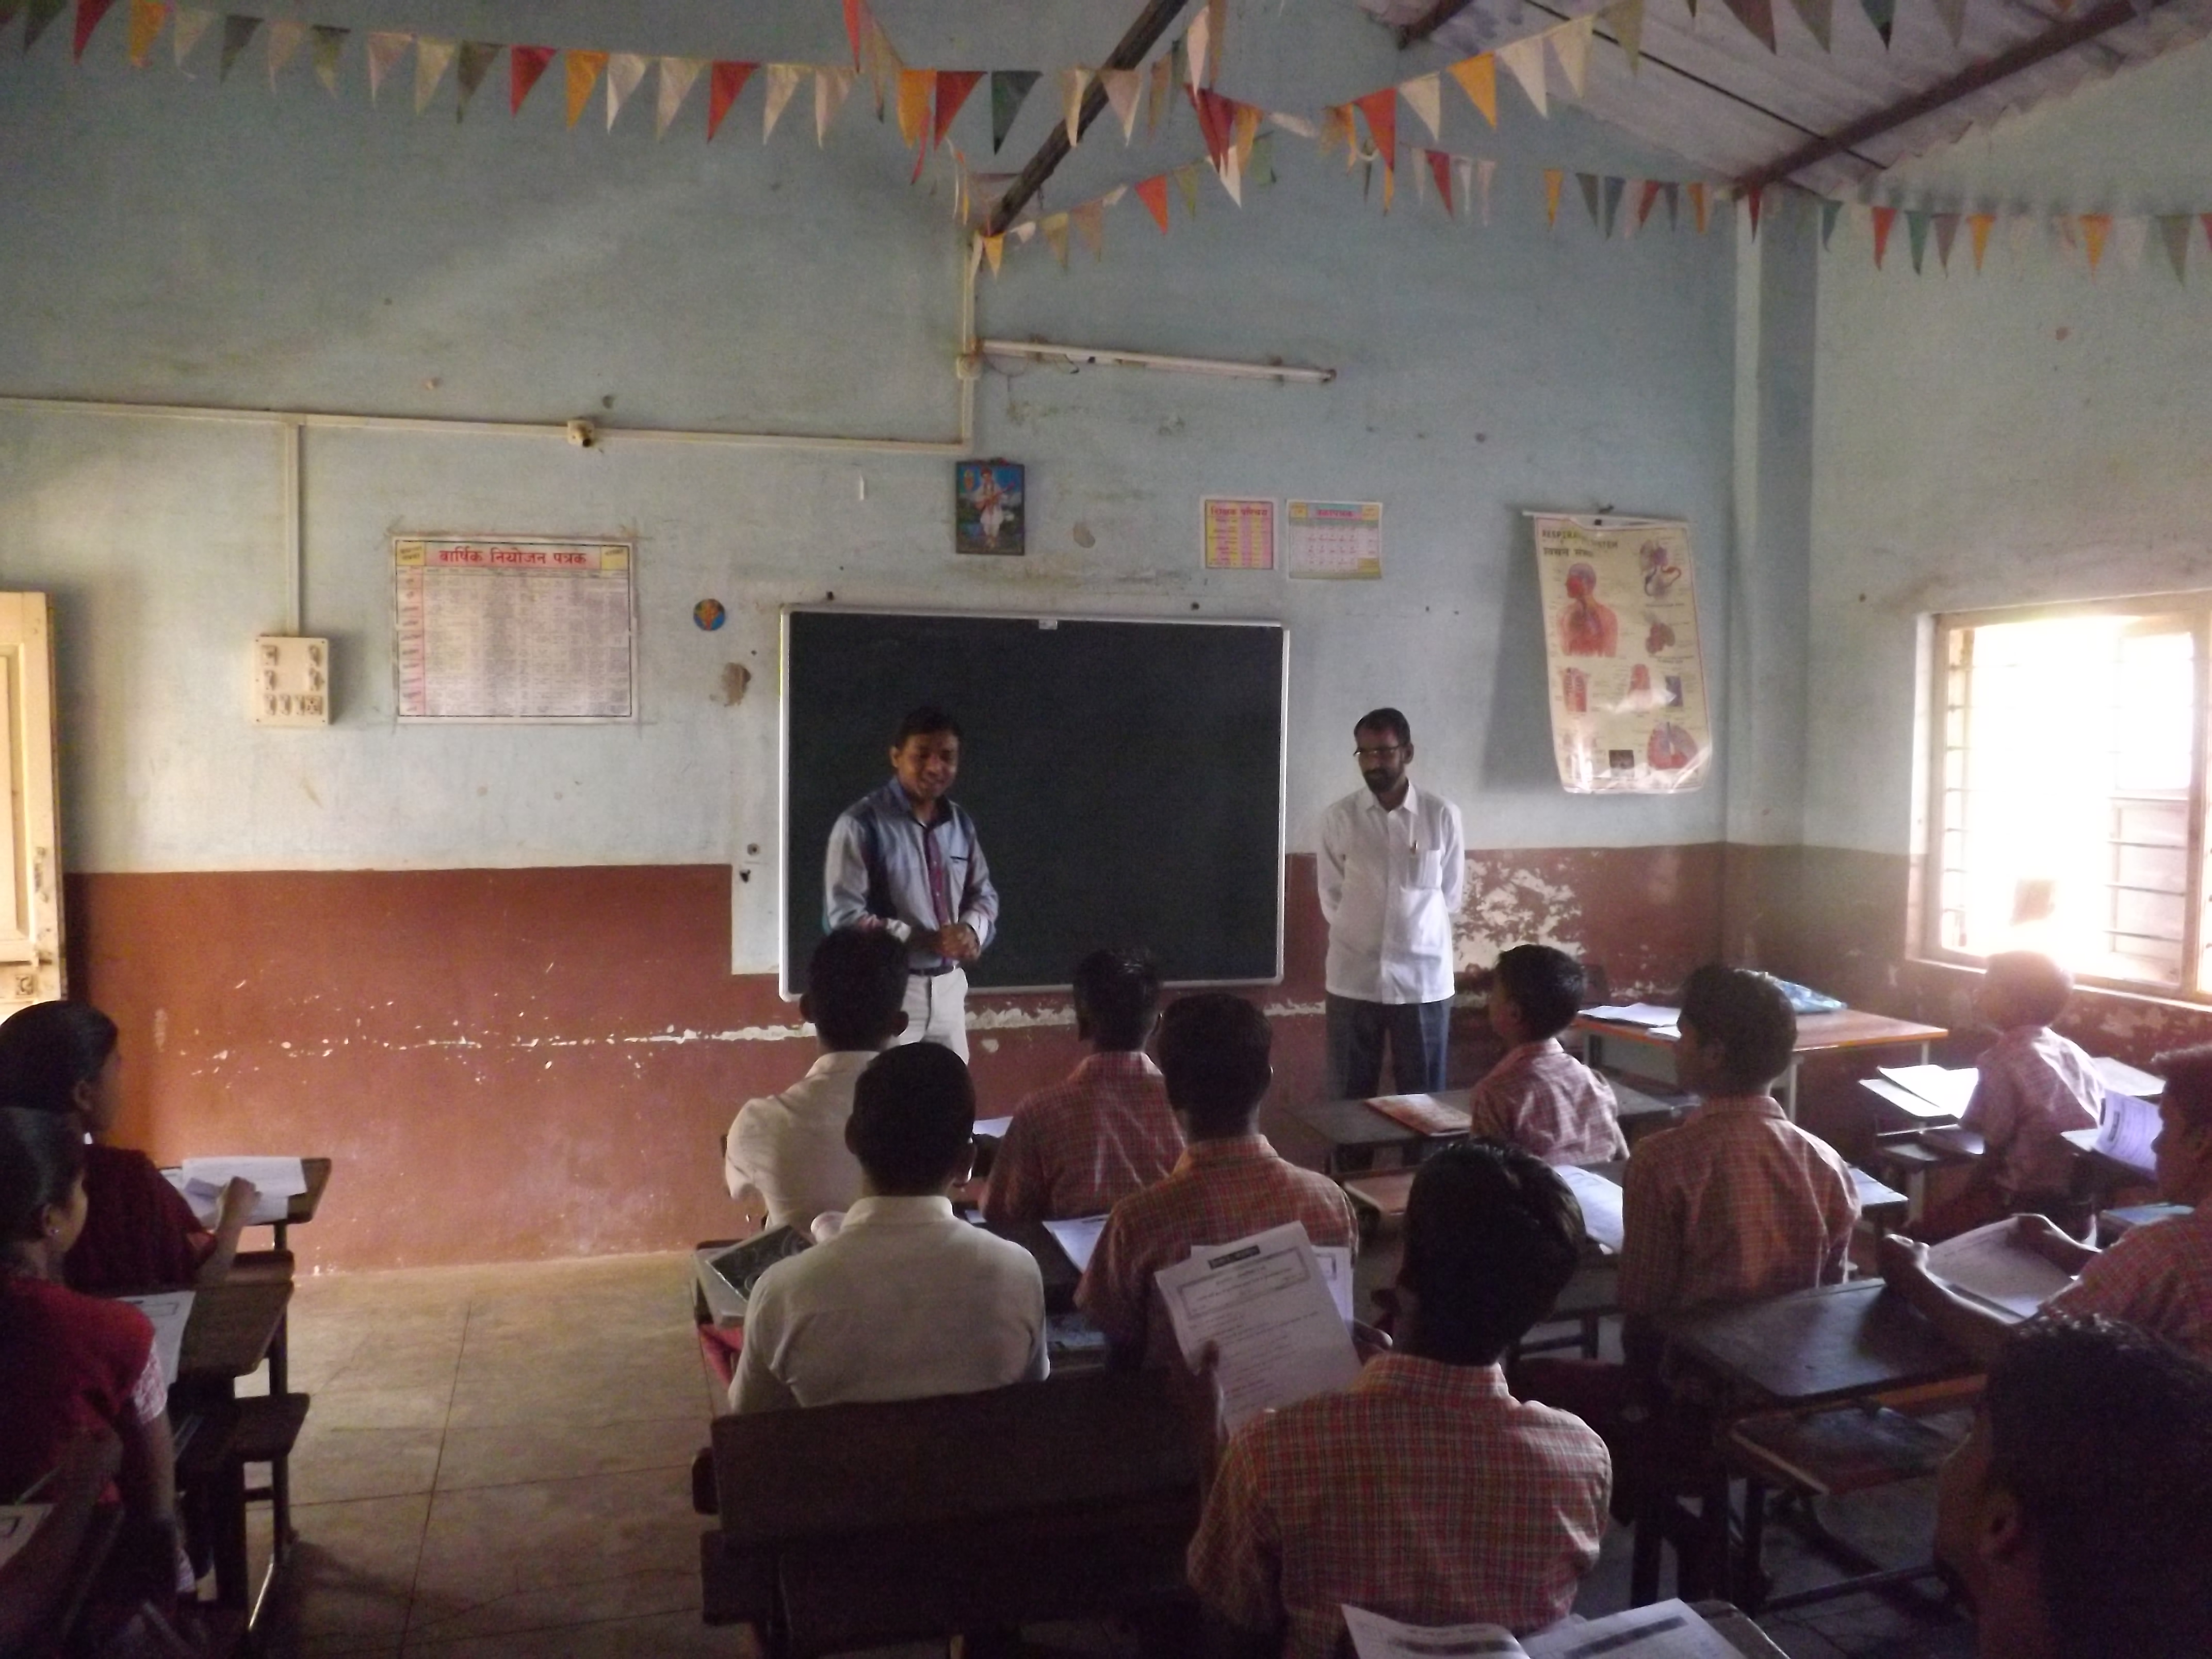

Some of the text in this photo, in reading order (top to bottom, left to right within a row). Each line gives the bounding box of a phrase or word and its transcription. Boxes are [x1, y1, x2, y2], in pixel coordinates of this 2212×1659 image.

[440, 546, 483, 562] वार्षिक
[490, 547, 546, 564] नियोजन
[554, 550, 587, 564] पत्रक
